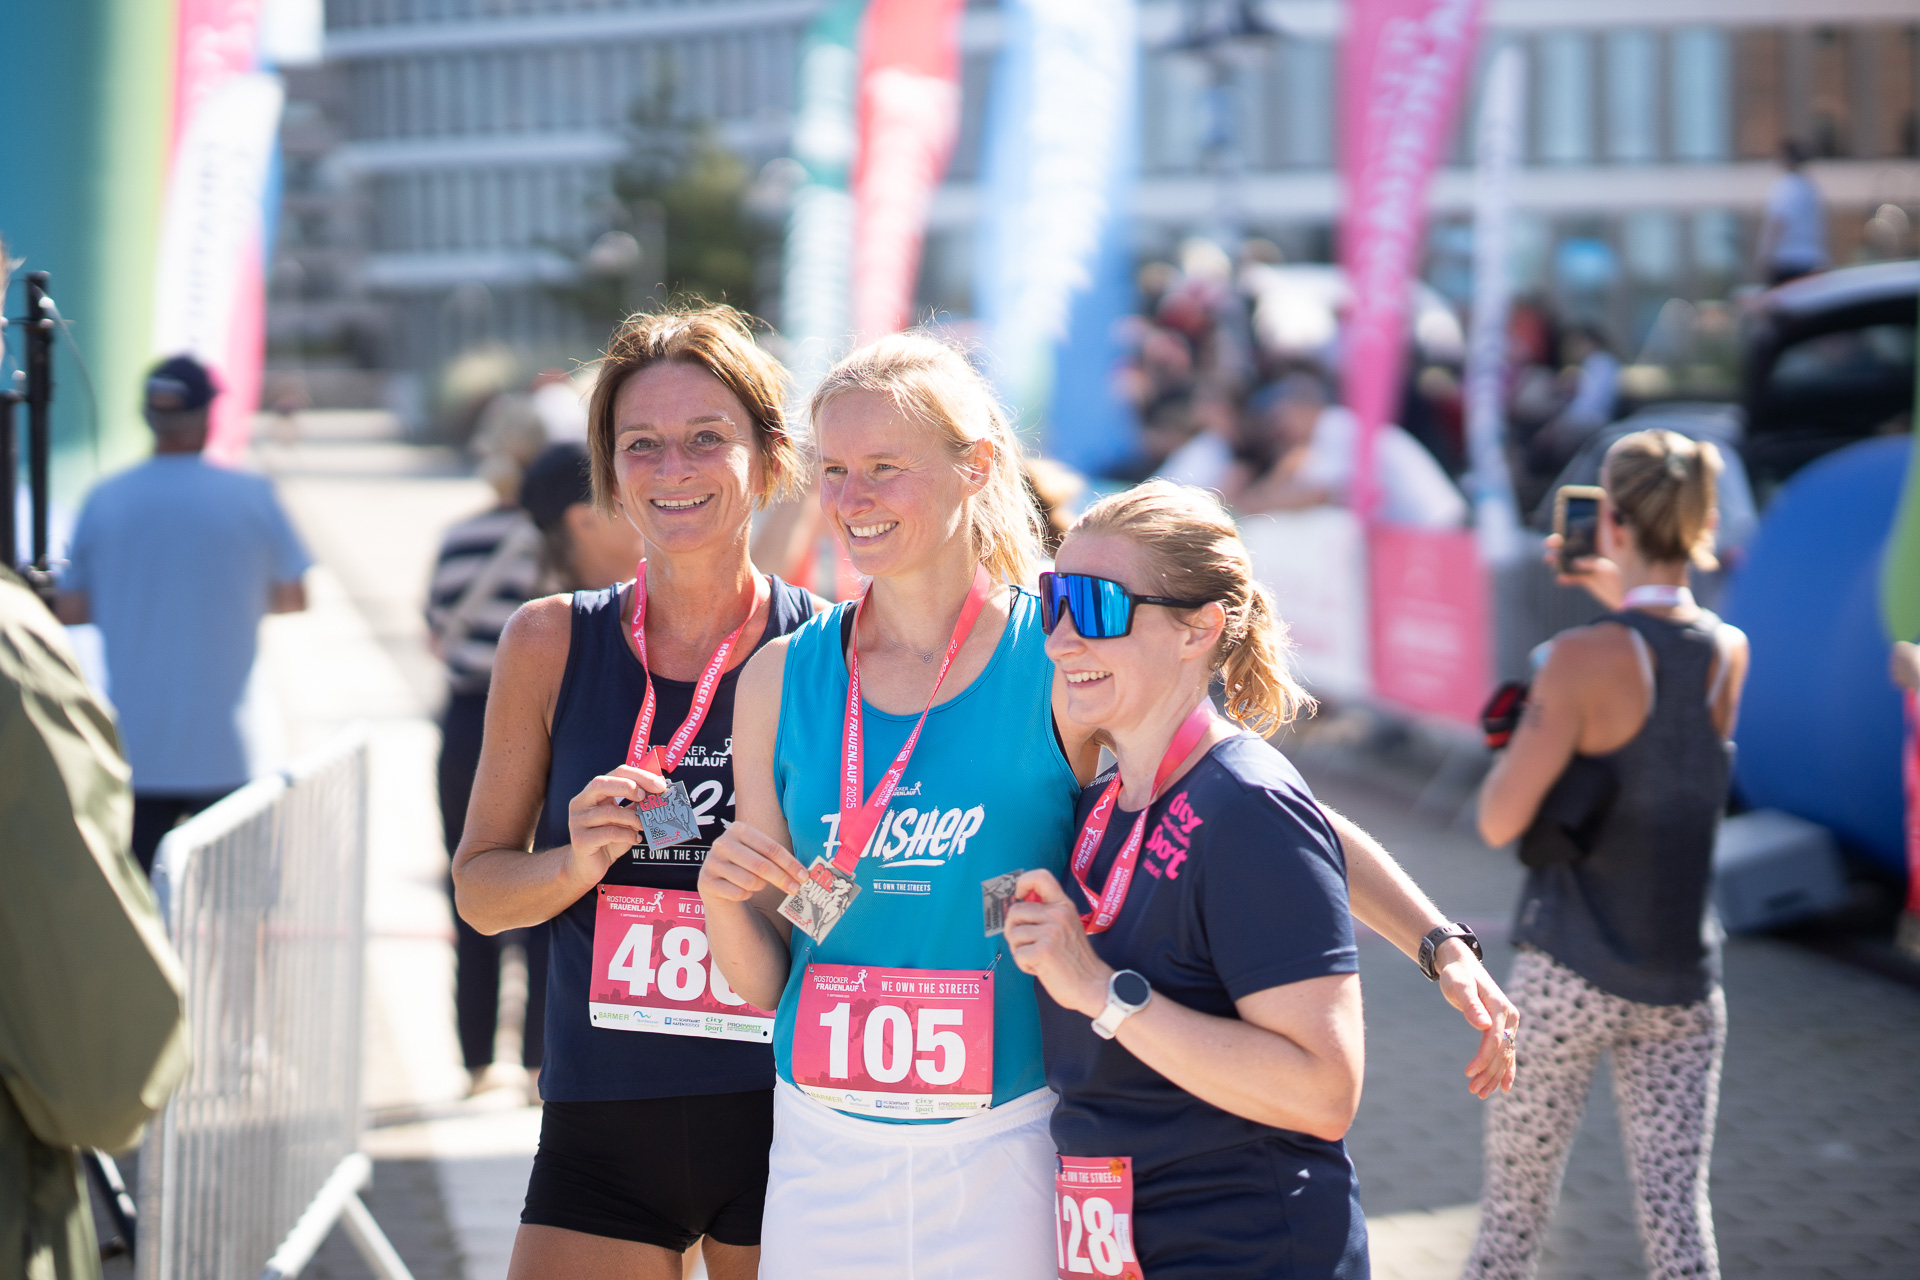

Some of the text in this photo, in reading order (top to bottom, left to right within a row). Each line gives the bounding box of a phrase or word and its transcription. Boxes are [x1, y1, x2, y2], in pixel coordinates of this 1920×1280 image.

[697, 643, 729, 704] ROSTOCKER
[846, 716, 858, 784] FRAUENLAUF
[639, 793, 668, 811] GRL
[845, 786, 857, 808] 2025
[632, 848, 646, 860] WE
[650, 849, 670, 861] OWN
[674, 850, 691, 861] THE
[873, 882, 882, 890] WE
[896, 883, 906, 891] THE
[907, 884, 931, 892] STREETS
[607, 895, 645, 904] ROSTOCKER
[610, 903, 656, 913] FRAUENLAUF
[678, 903, 691, 913] WE
[813, 975, 848, 984] ROSTOCKER
[816, 983, 860, 992] FRAUENLAUF
[881, 981, 980, 994] WE OWN THE STREETS
[598, 1011, 630, 1021] BARMER
[819, 1002, 966, 1086] 105
[1079, 1172, 1090, 1183] THE
